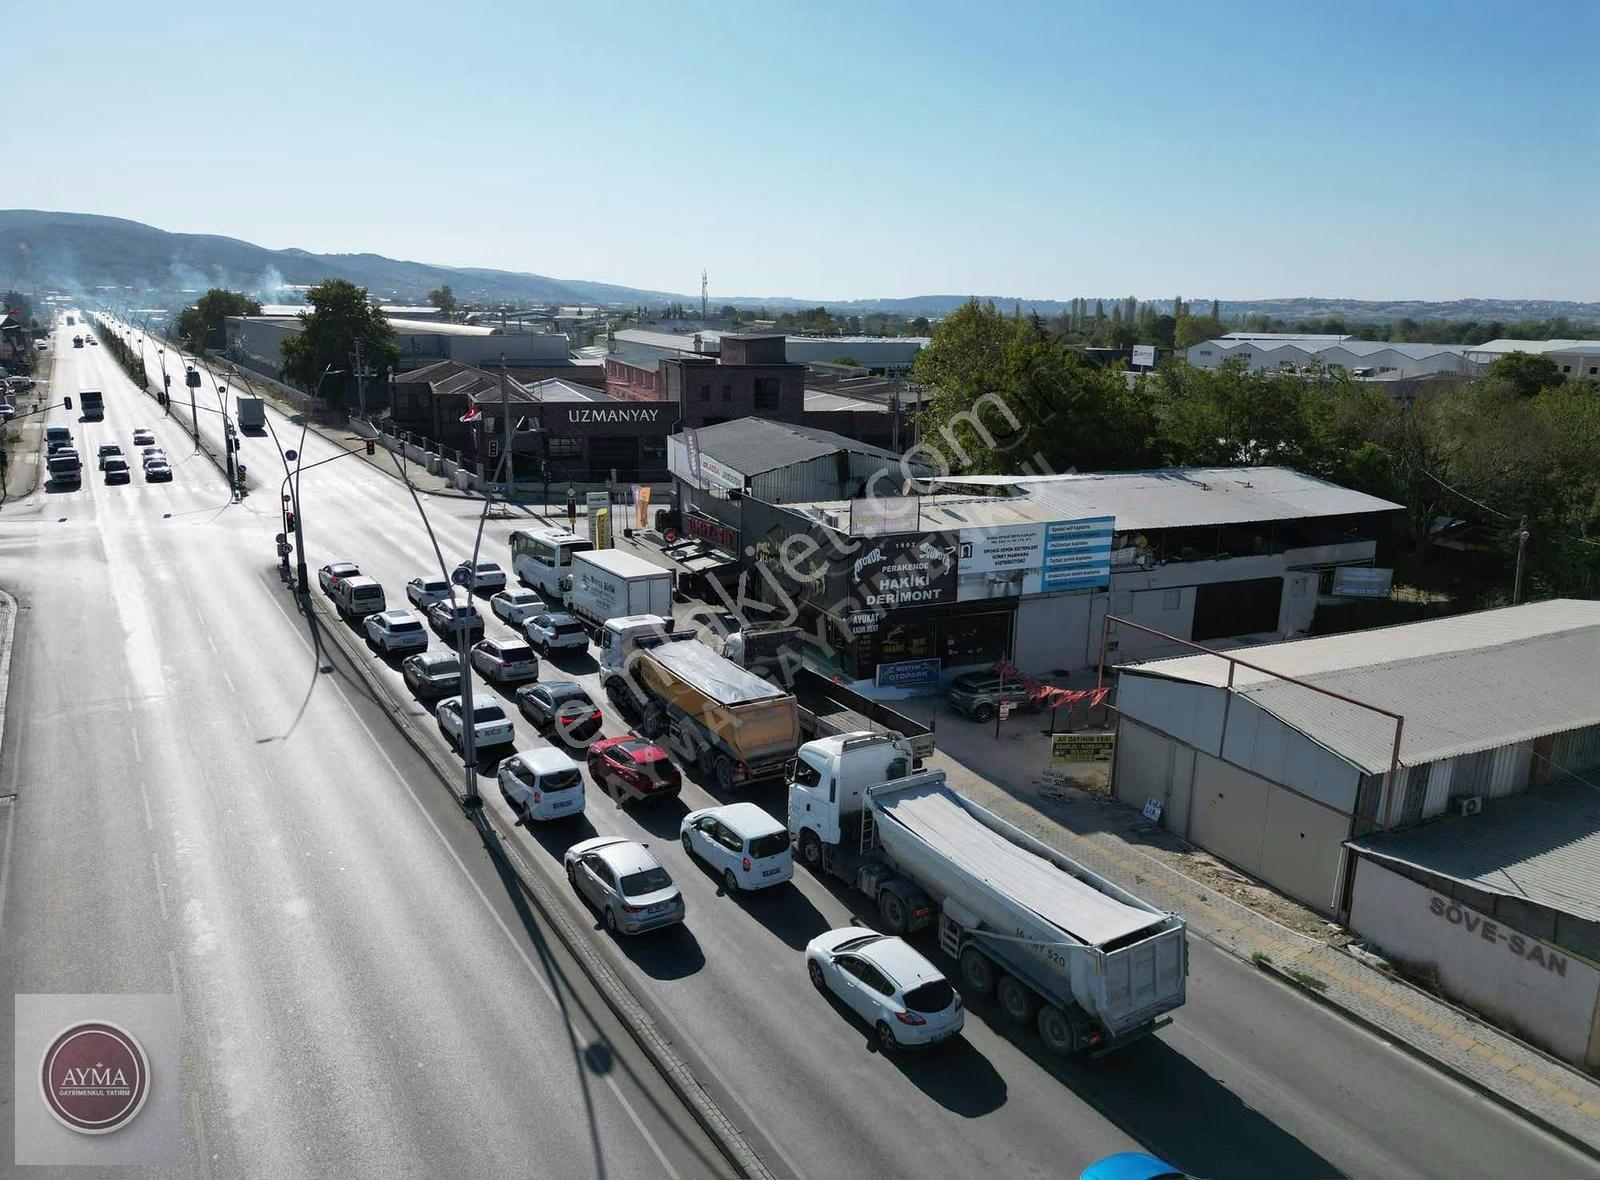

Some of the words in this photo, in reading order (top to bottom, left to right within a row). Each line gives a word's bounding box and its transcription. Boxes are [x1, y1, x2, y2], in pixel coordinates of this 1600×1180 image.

[568, 409, 659, 423] UZMANYAY
[881, 562, 929, 573] PERAKENDE
[880, 574, 930, 590] HAKİKİ
[866, 588, 942, 606] DERİMONT
[853, 613, 879, 624] AVUKAT
[889, 671, 929, 681] OTOPARK
[1429, 896, 1568, 978] SÖVE-SAN
